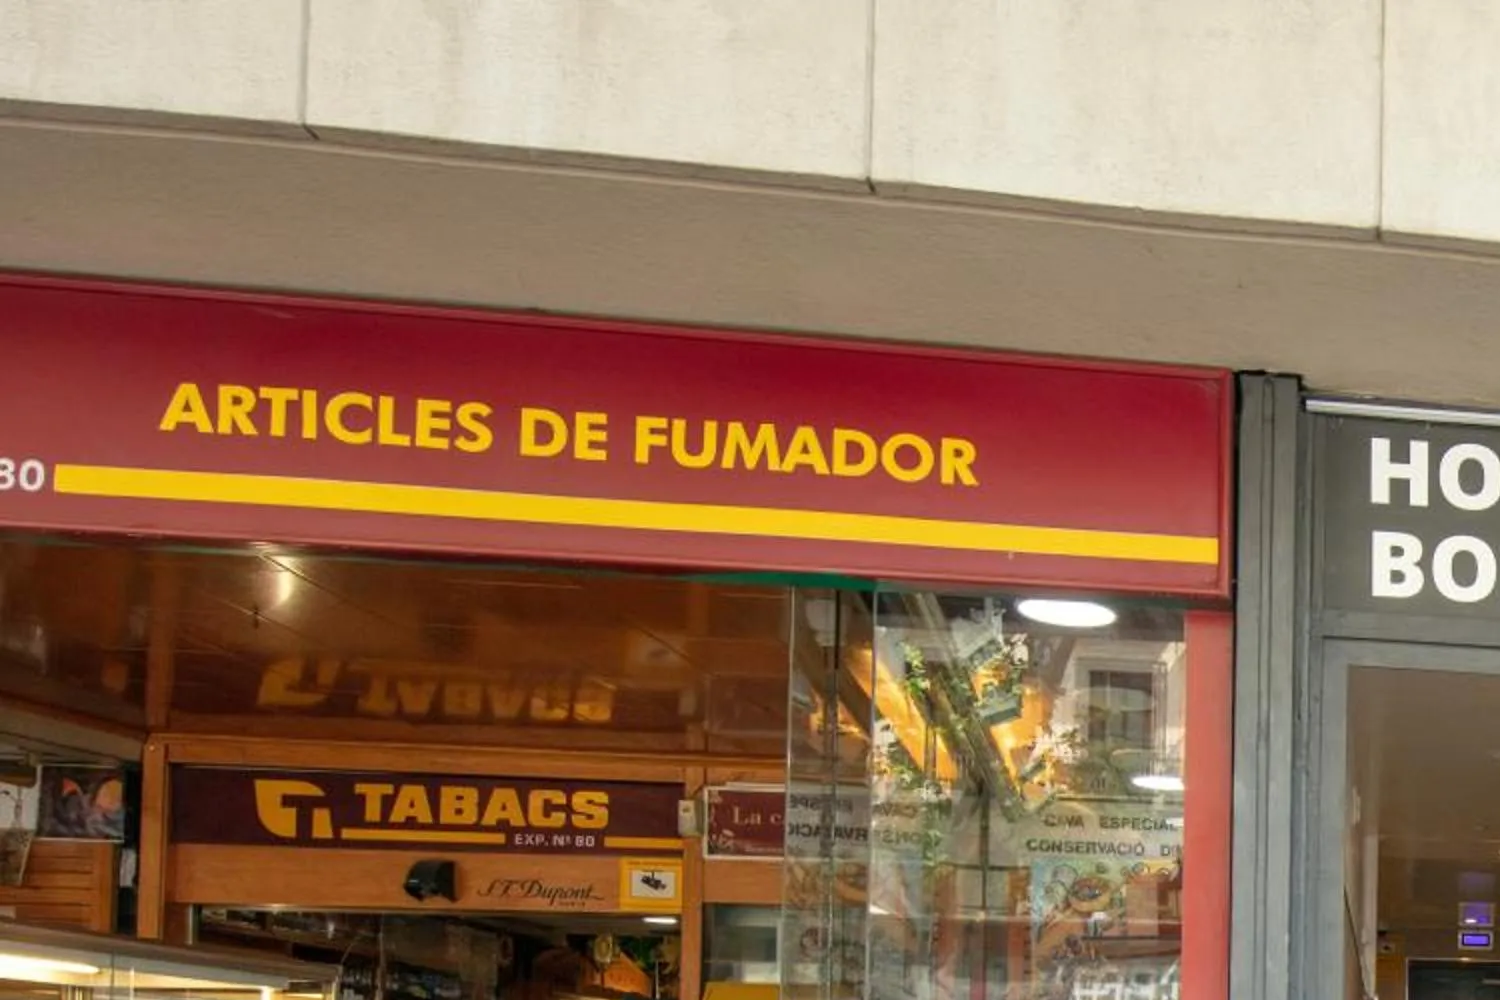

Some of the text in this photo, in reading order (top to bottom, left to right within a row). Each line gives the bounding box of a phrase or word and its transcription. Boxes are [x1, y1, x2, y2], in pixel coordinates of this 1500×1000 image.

[159, 383, 979, 486] ARTICLES DE FUMADOR
[354, 783, 609, 829] TABACS
[514, 833, 549, 847] EXP.
[574, 835, 596, 848] 80
[519, 879, 604, 906] Dupont
